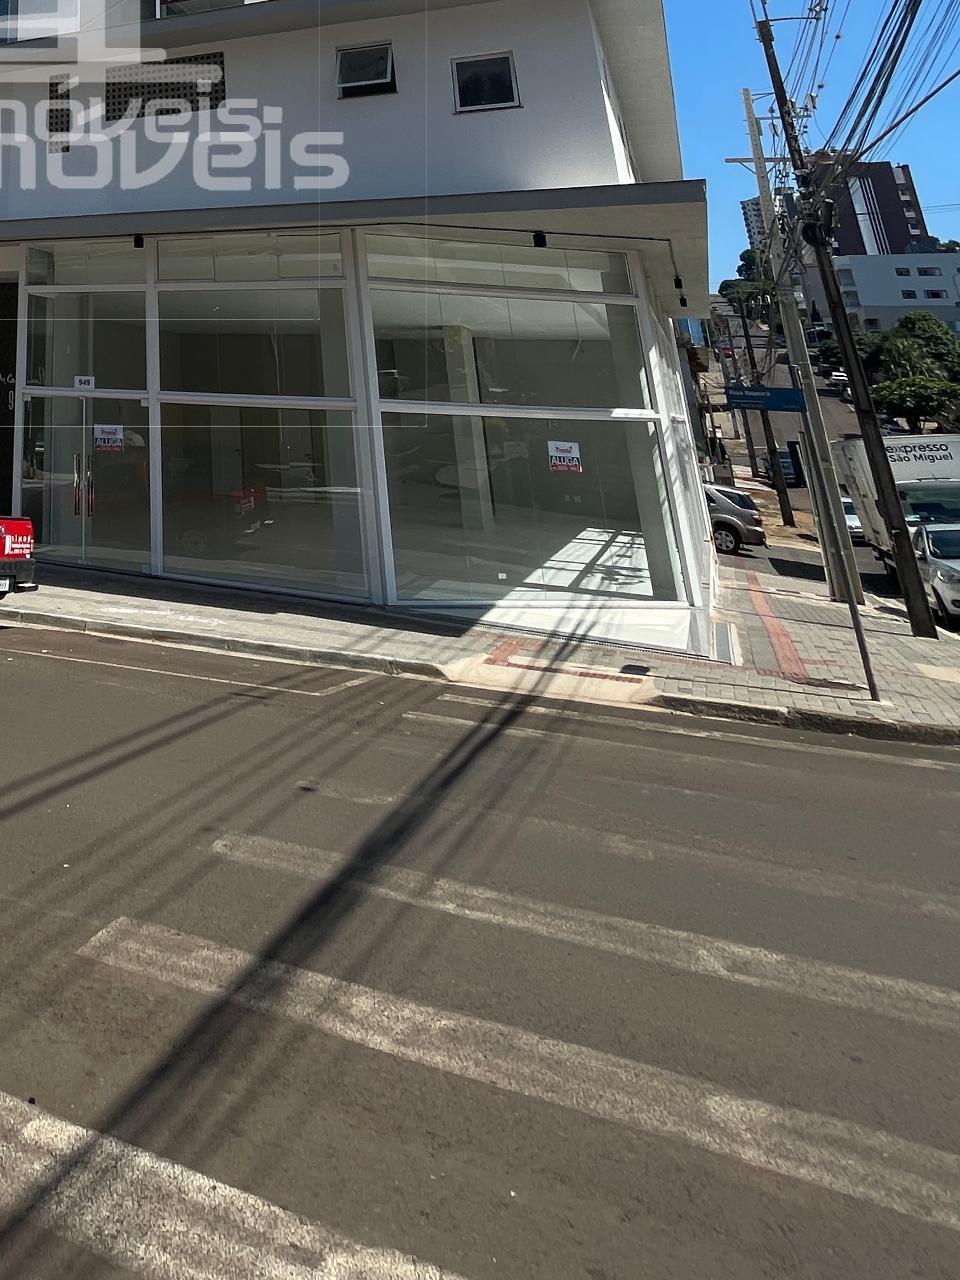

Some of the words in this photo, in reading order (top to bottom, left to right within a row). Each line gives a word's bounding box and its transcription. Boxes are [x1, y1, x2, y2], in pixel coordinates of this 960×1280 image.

[96, 438, 122, 446] ALUGA
[551, 456, 579, 466] ALUGA
[889, 453, 910, 462] São
[913, 452, 954, 463] Miguel
